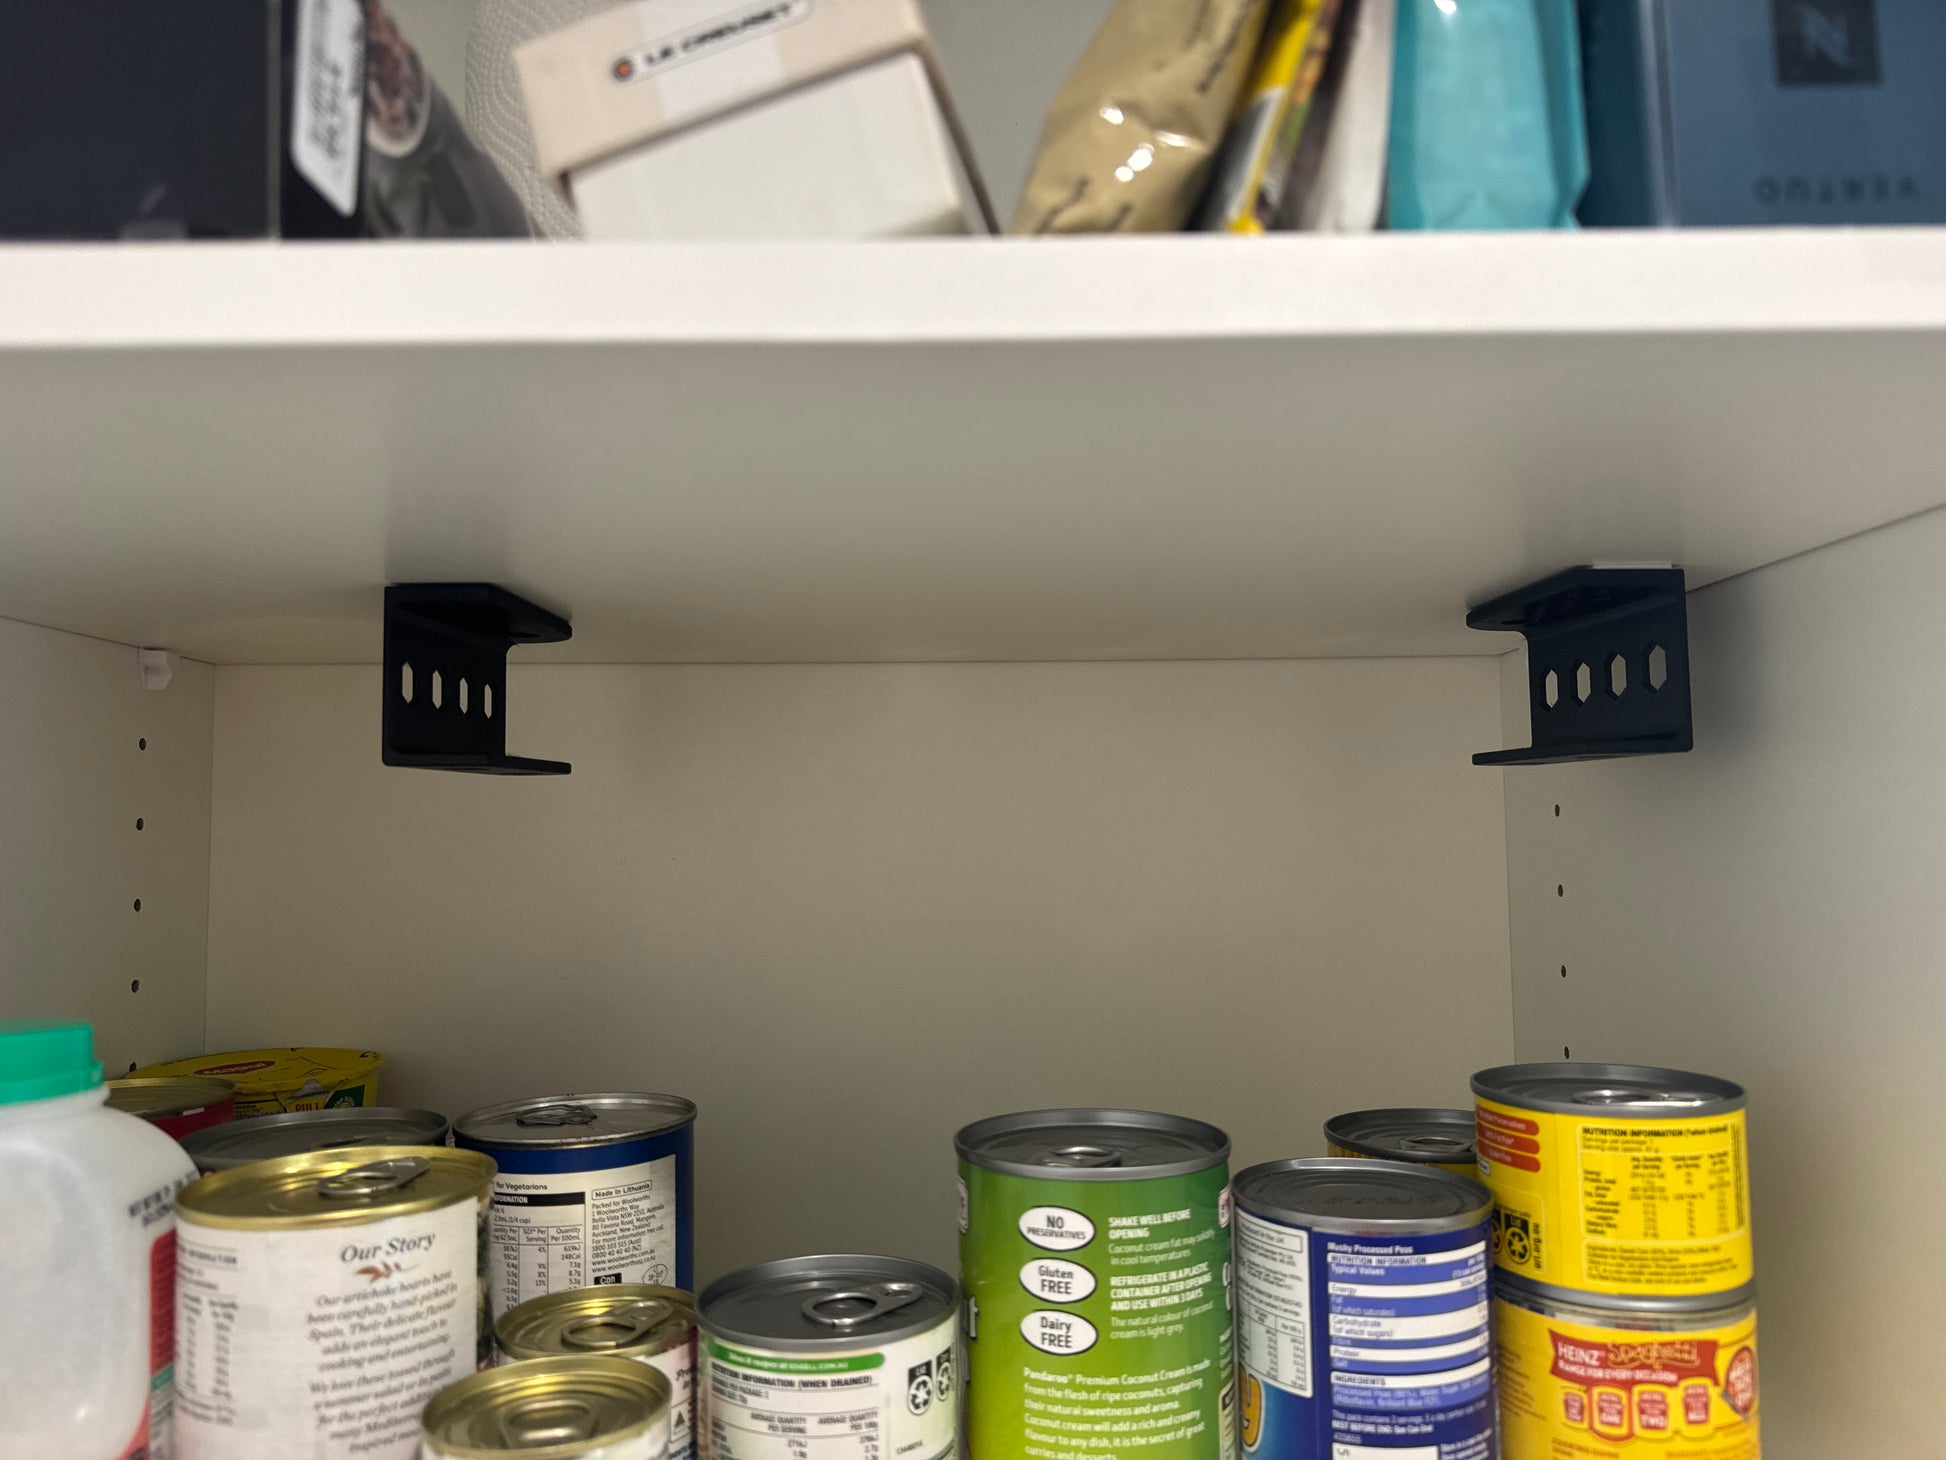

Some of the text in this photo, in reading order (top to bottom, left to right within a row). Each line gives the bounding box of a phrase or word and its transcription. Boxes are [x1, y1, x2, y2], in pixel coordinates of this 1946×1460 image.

[1582, 1127, 1627, 1137] NUTRITION
[1630, 1128, 1683, 1138] INFORMATION
[496, 1181, 548, 1191] for Vegetarians
[595, 1182, 650, 1198] Made in Lithuania
[592, 1202, 612, 1210] Packed
[621, 1194, 651, 1206] Woolworths
[592, 1216, 606, 1224] Bella
[607, 1214, 619, 1222] Vista
[620, 1211, 632, 1219] NSW
[596, 1205, 628, 1216] Woolworths
[1108, 1208, 1191, 1228] SHAKE WELL BEFORE
[619, 1225, 631, 1234] New
[632, 1221, 651, 1232] Zealand
[1046, 1214, 1065, 1229] NO
[556, 1227, 581, 1236] Quantity
[592, 1229, 647, 1246] For more information
[1027, 1226, 1088, 1241] PRESERVATIVES
[1109, 1227, 1150, 1240] OPENING
[340, 1233, 437, 1264] Our Story
[1108, 1242, 1169, 1254] Coconut cream
[1327, 1241, 1413, 1254] Mushy Processed Peas
[1331, 1255, 1427, 1265] NUTRITION INFORMATION
[1038, 1265, 1074, 1280] Gluten
[1331, 1264, 1386, 1276] Typical Values
[399, 1278, 432, 1293] hearts
[600, 1275, 616, 1285] Can
[1041, 1279, 1072, 1295] FREE
[1110, 1273, 1169, 1287] REFRIGERATE
[1111, 1272, 1213, 1299] CONTAINER AFTER OPENING
[1331, 1284, 1358, 1296] Energy
[1111, 1287, 1203, 1311] AND USE WITHIN DAYS
[337, 1302, 388, 1321] carefully
[348, 1320, 382, 1336] Their
[383, 1310, 426, 1328] delicate
[1040, 1316, 1072, 1334] Dairy
[1111, 1316, 1128, 1327] The
[1128, 1315, 1158, 1326] natural
[1332, 1316, 1382, 1328] Carbohydrate
[1111, 1330, 1137, 1339] cream
[1344, 1328, 1365, 1337] which
[1041, 1332, 1073, 1349] FREE
[1557, 1342, 1600, 1366] HEINZ
[1075, 1369, 1186, 1386] Premium Coconut Cream
[1334, 1375, 1387, 1386] INGREDIENTS
[1587, 1365, 1604, 1379] FOR
[1604, 1367, 1633, 1381] EVERY
[741, 1373, 796, 1388] INFORMATION
[798, 1378, 828, 1389] (WHEN
[830, 1375, 873, 1388] DRAINED)
[1024, 1382, 1047, 1395] from
[1047, 1386, 1063, 1399] the
[1064, 1388, 1088, 1400] flesh
[1089, 1389, 1101, 1401] of
[1102, 1391, 1121, 1405] ripe
[1167, 1377, 1204, 1396] capturing
[1024, 1398, 1047, 1410] their
[1047, 1403, 1081, 1416] natural
[1082, 1407, 1133, 1417] sweetness
[1133, 1403, 1152, 1415] and
[777, 1415, 808, 1424] QUANTITY
[818, 1411, 879, 1425] AVERAGE QUANTITY
[1024, 1412, 1061, 1429] Coconut
[1062, 1420, 1092, 1431] cream
[1093, 1420, 1110, 1432] will
[1111, 1420, 1130, 1432] add
[1138, 1418, 1156, 1430] rich
[1156, 1415, 1173, 1427] and
[1331, 1419, 1349, 1430] BEST
[1349, 1422, 1376, 1432] BEFORE
[1024, 1428, 1057, 1443] flavour
[1058, 1435, 1070, 1446] to
[1070, 1437, 1087, 1450] any
[1131, 1435, 1148, 1447] the
[1148, 1431, 1176, 1446] secret
[1024, 1445, 1057, 1459] curries
